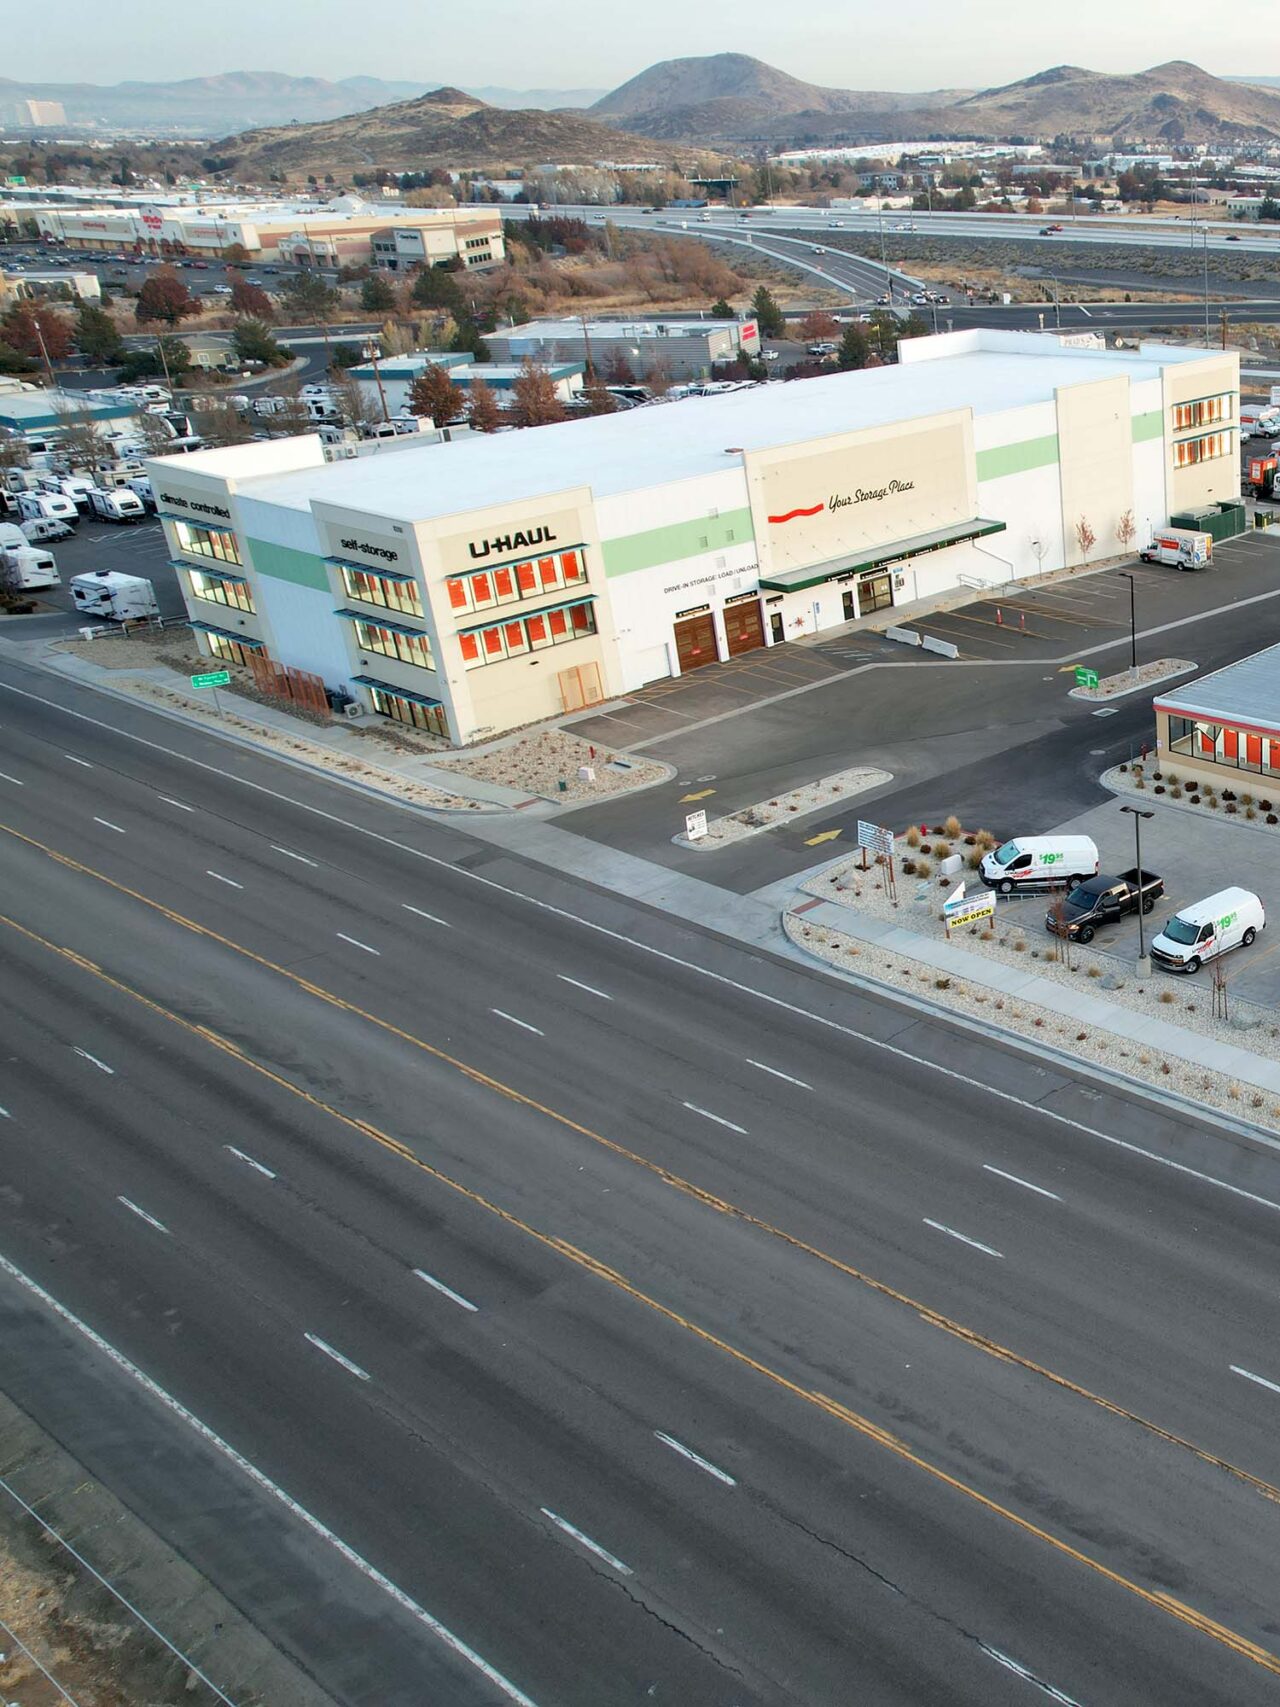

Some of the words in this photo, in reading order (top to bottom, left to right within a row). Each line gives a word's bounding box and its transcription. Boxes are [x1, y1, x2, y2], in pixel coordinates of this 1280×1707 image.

[160, 492, 188, 509] climate
[190, 501, 231, 519] controlled
[828, 494, 852, 513] Your
[853, 488, 889, 504] Storage
[888, 479, 915, 494] Place
[341, 537, 398, 561] self-storage
[468, 525, 557, 559] U-HAUL
[663, 583, 689, 594] DRIVE-IN
[718, 569, 734, 579] LOAD
[736, 563, 759, 575] UNLOAD
[951, 915, 970, 926] NOW
[970, 908, 992, 919] OPEN
